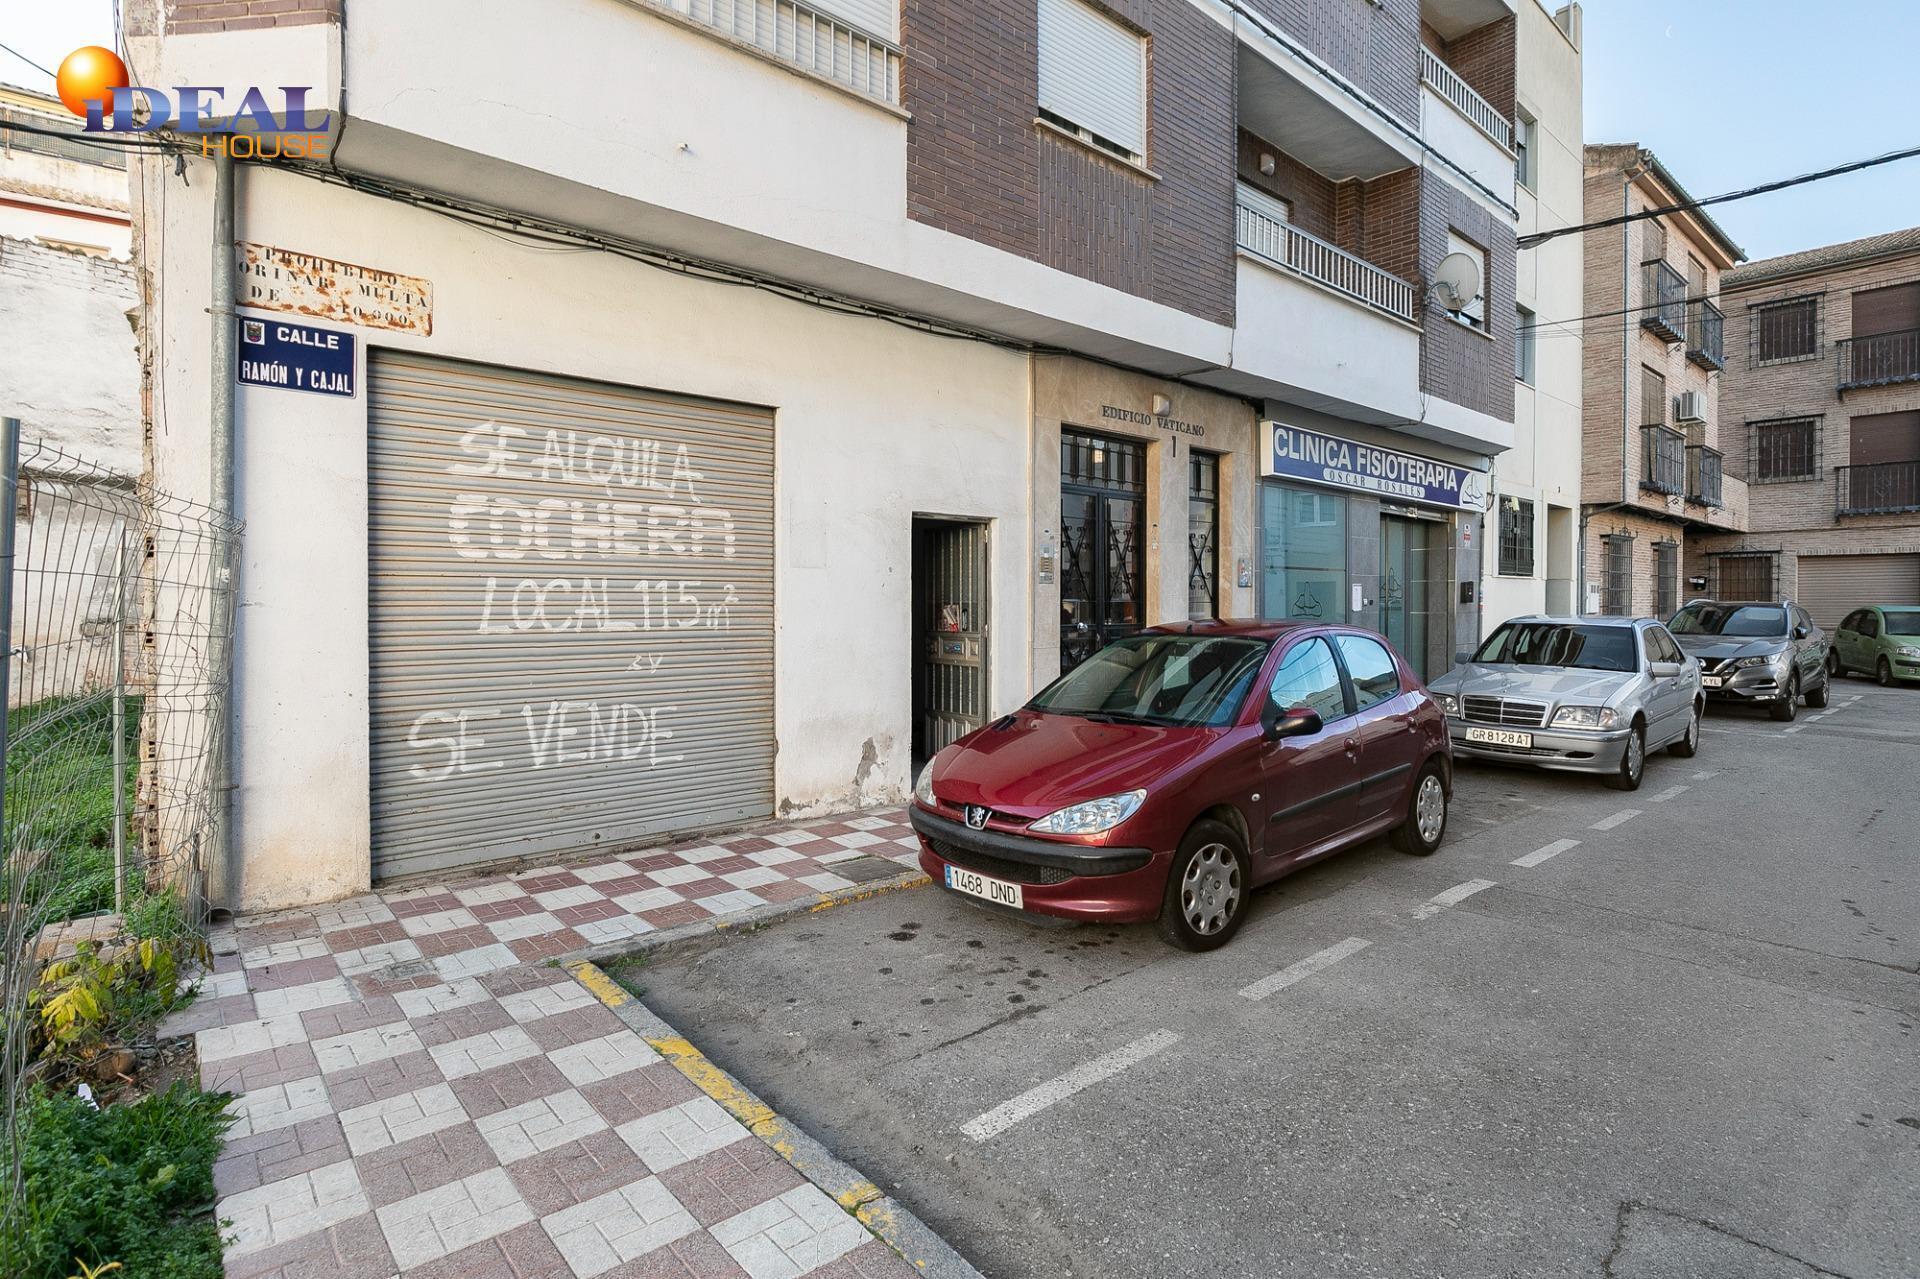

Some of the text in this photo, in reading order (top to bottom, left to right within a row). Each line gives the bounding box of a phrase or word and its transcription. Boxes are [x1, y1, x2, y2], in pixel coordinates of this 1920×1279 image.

[238, 261, 427, 308] ORINAR MULTA
[251, 285, 280, 302] DE
[277, 326, 339, 350] CALLE
[242, 360, 352, 393] RAMÓN Y CAJAL
[1101, 405, 1205, 437] EDIFICIO VATICANO
[446, 420, 704, 504] SE ALQUILA
[1273, 427, 1458, 492] CLINICA FISIOTERAPIA
[1329, 470, 1422, 497] OSCAR ROSALES
[448, 494, 737, 560] COCHERA
[477, 576, 636, 635] LOCAL
[633, 579, 702, 631] 115
[407, 699, 685, 782] SE VENDE
[954, 869, 983, 895] 1468
